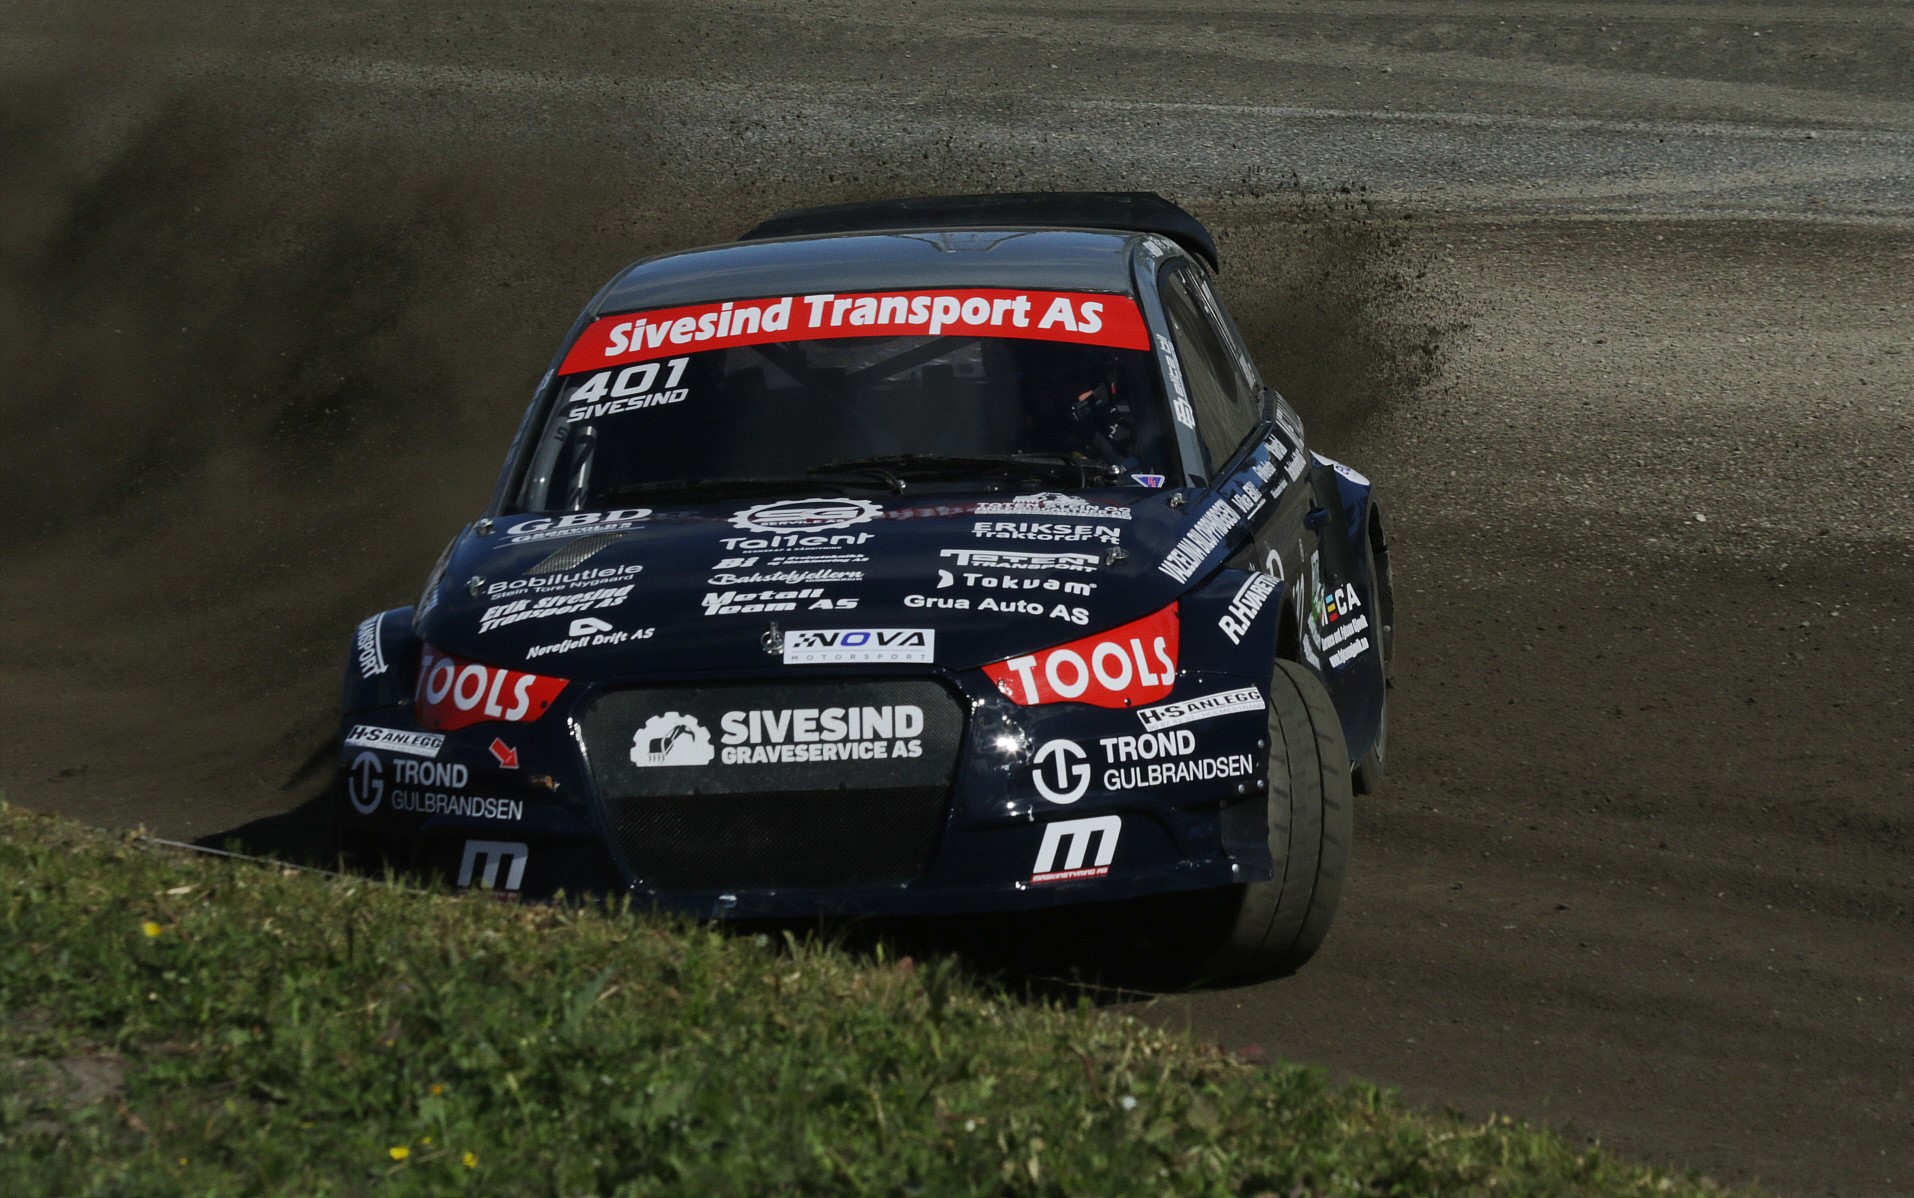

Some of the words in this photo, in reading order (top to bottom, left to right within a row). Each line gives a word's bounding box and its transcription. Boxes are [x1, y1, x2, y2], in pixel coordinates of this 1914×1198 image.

[604, 297, 793, 357] Sivesind
[804, 294, 1031, 335] Transport
[1038, 297, 1104, 334] AS
[570, 357, 690, 403] 401
[567, 389, 689, 423] SIVESIND
[507, 508, 653, 535] GBD
[973, 522, 1121, 538] ERIKSEN
[971, 530, 1120, 545] Traktordrft
[711, 556, 760, 570] BI
[940, 549, 1099, 566] TOTEN
[970, 560, 1098, 573] TRANSPORT
[1158, 536, 1209, 584] VAZELINA
[487, 565, 644, 595] Bobilutleie
[490, 586, 529, 600] Stein
[534, 584, 566, 593] Tore
[569, 574, 634, 588] Nygaard
[478, 601, 595, 634] Transport
[594, 596, 628, 609] AS
[480, 599, 533, 623] Erik
[533, 584, 636, 609] Sivesind
[808, 598, 860, 610] AS
[903, 594, 970, 611] Grua
[977, 598, 1044, 616] Auto
[1049, 604, 1090, 626] AS
[526, 635, 591, 661] Norefjell
[591, 631, 629, 646] Drift
[631, 627, 656, 641] AS
[804, 632, 926, 648] NOVA
[791, 653, 927, 662] MOTORSPORT
[1007, 636, 1176, 705] TOOLS
[415, 654, 537, 722] TOOLS
[1187, 691, 1261, 712] ANLEGG
[720, 704, 924, 745] SIVESIND
[382, 732, 443, 749] ANLEGG
[721, 741, 888, 765] GRAVESERVICE
[892, 739, 923, 758] AS
[1100, 729, 1196, 764] TROND
[393, 759, 469, 788] TROND
[1103, 754, 1253, 791] GULBRANDSEN
[391, 789, 523, 821] GULBRANDSEN
